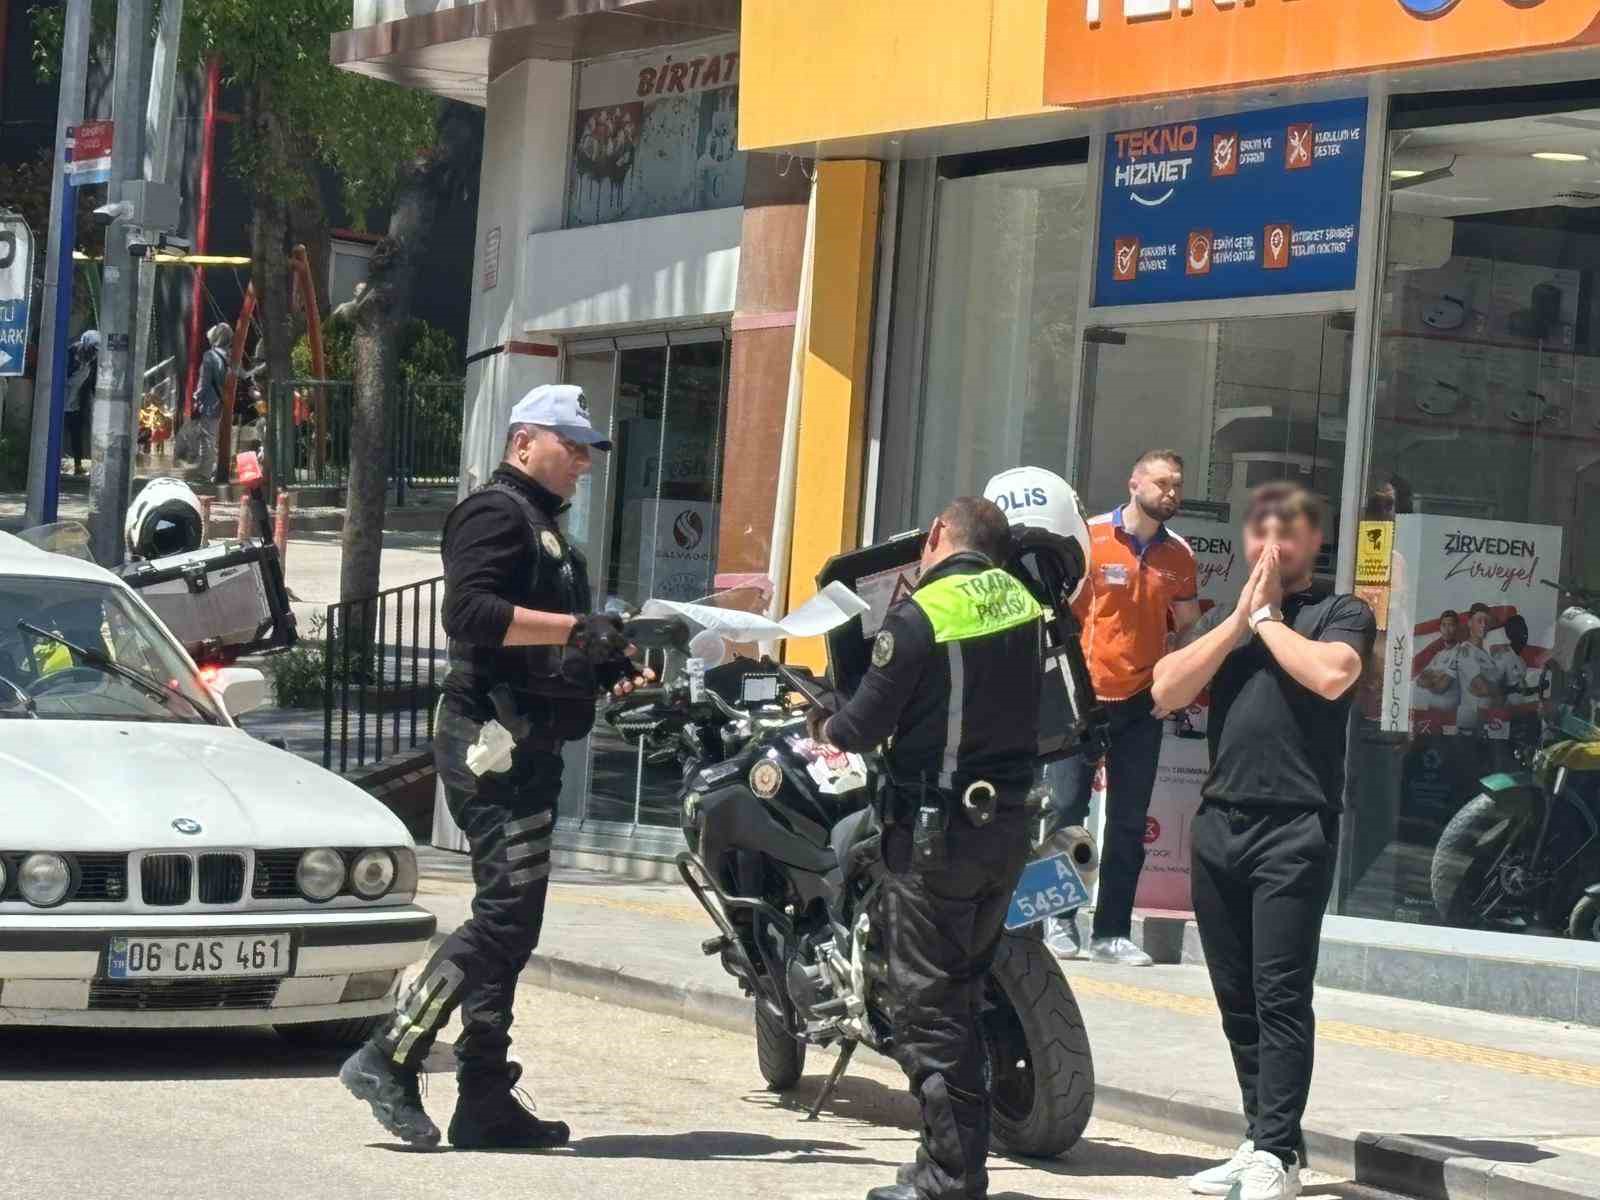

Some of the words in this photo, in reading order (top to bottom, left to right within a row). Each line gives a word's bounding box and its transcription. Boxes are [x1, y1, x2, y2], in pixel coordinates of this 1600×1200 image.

[1115, 125, 1198, 159] TEKNO
[1114, 156, 1193, 187] HİZMET
[1444, 529, 1536, 558] ZİRVEDEN
[1017, 882, 1081, 917] 5452
[128, 942, 162, 972] 06
[174, 942, 225, 971] CAS
[236, 939, 280, 970] 461
